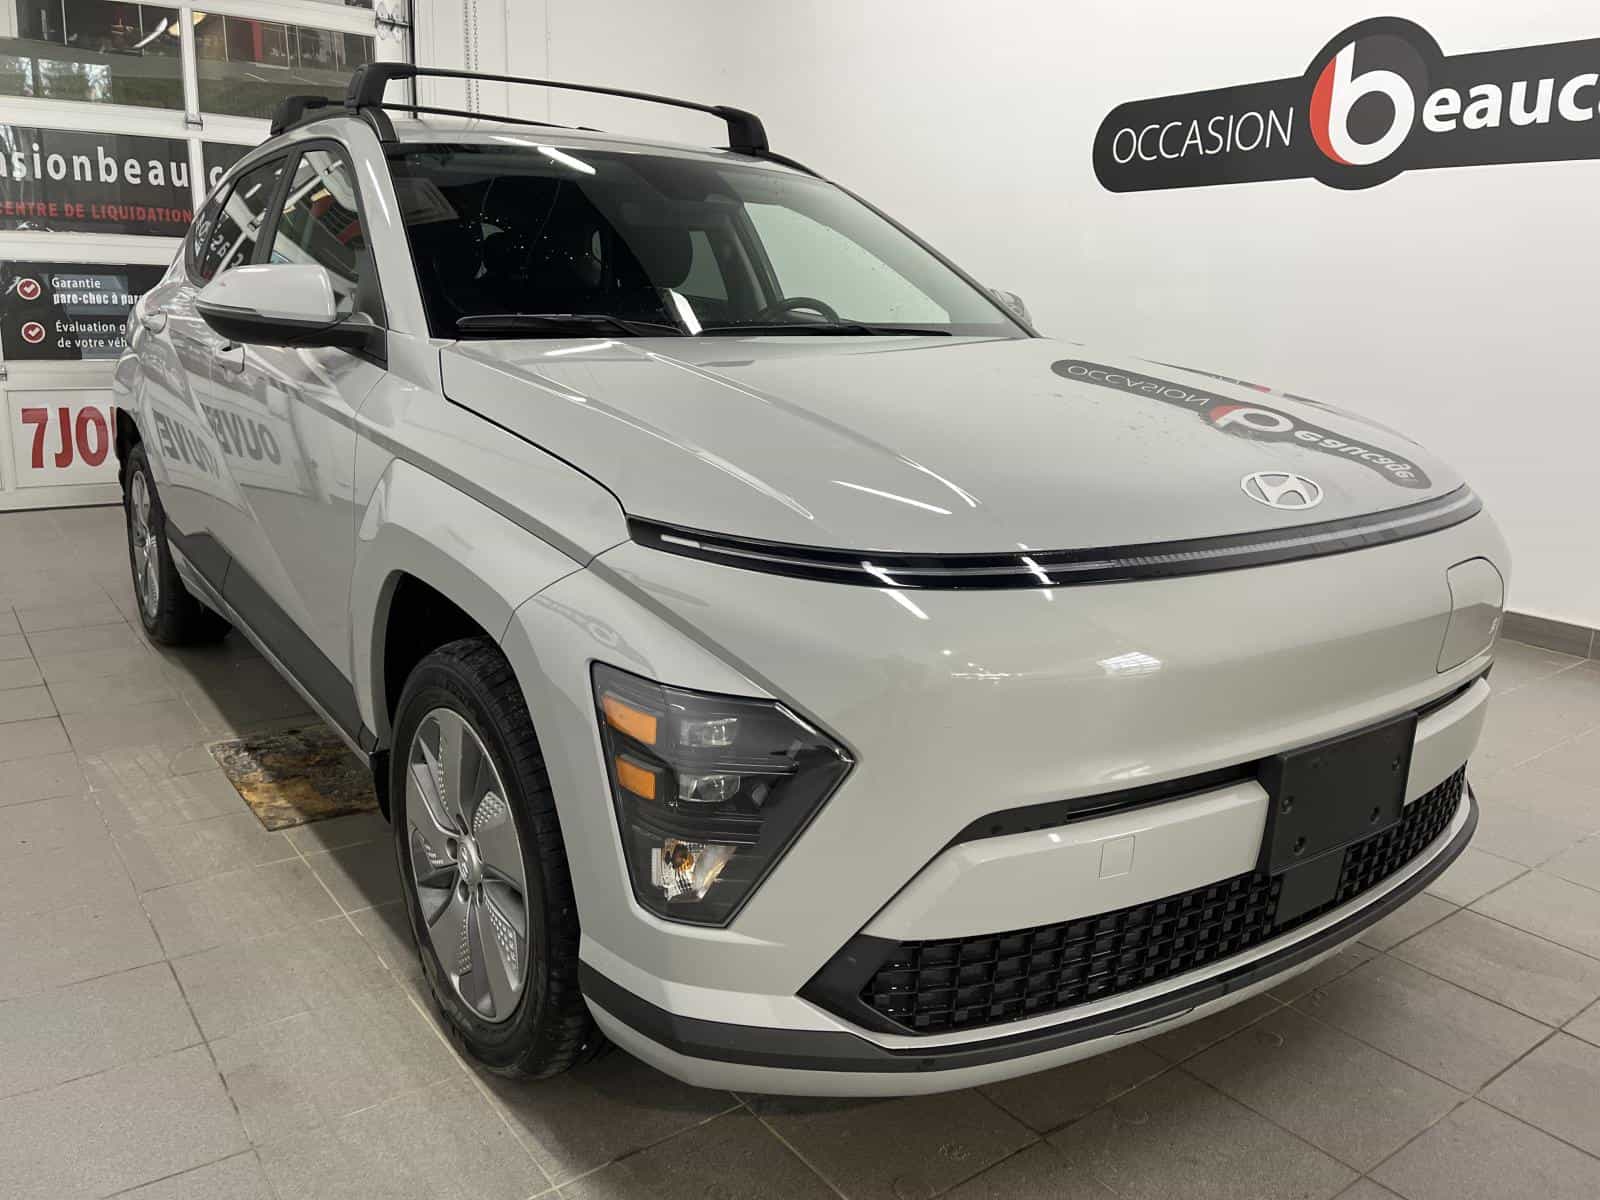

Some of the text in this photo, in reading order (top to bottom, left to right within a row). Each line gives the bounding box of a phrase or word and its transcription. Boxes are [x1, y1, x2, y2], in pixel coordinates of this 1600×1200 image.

[1113, 40, 1600, 165] OCCASION beauc
[64, 203, 85, 219] DE
[92, 203, 193, 225] LIQUIDATION
[51, 276, 101, 289] Garantie
[53, 291, 109, 306] pare-choc
[55, 319, 116, 333] Évaluation
[57, 336, 128, 348] de votre véh
